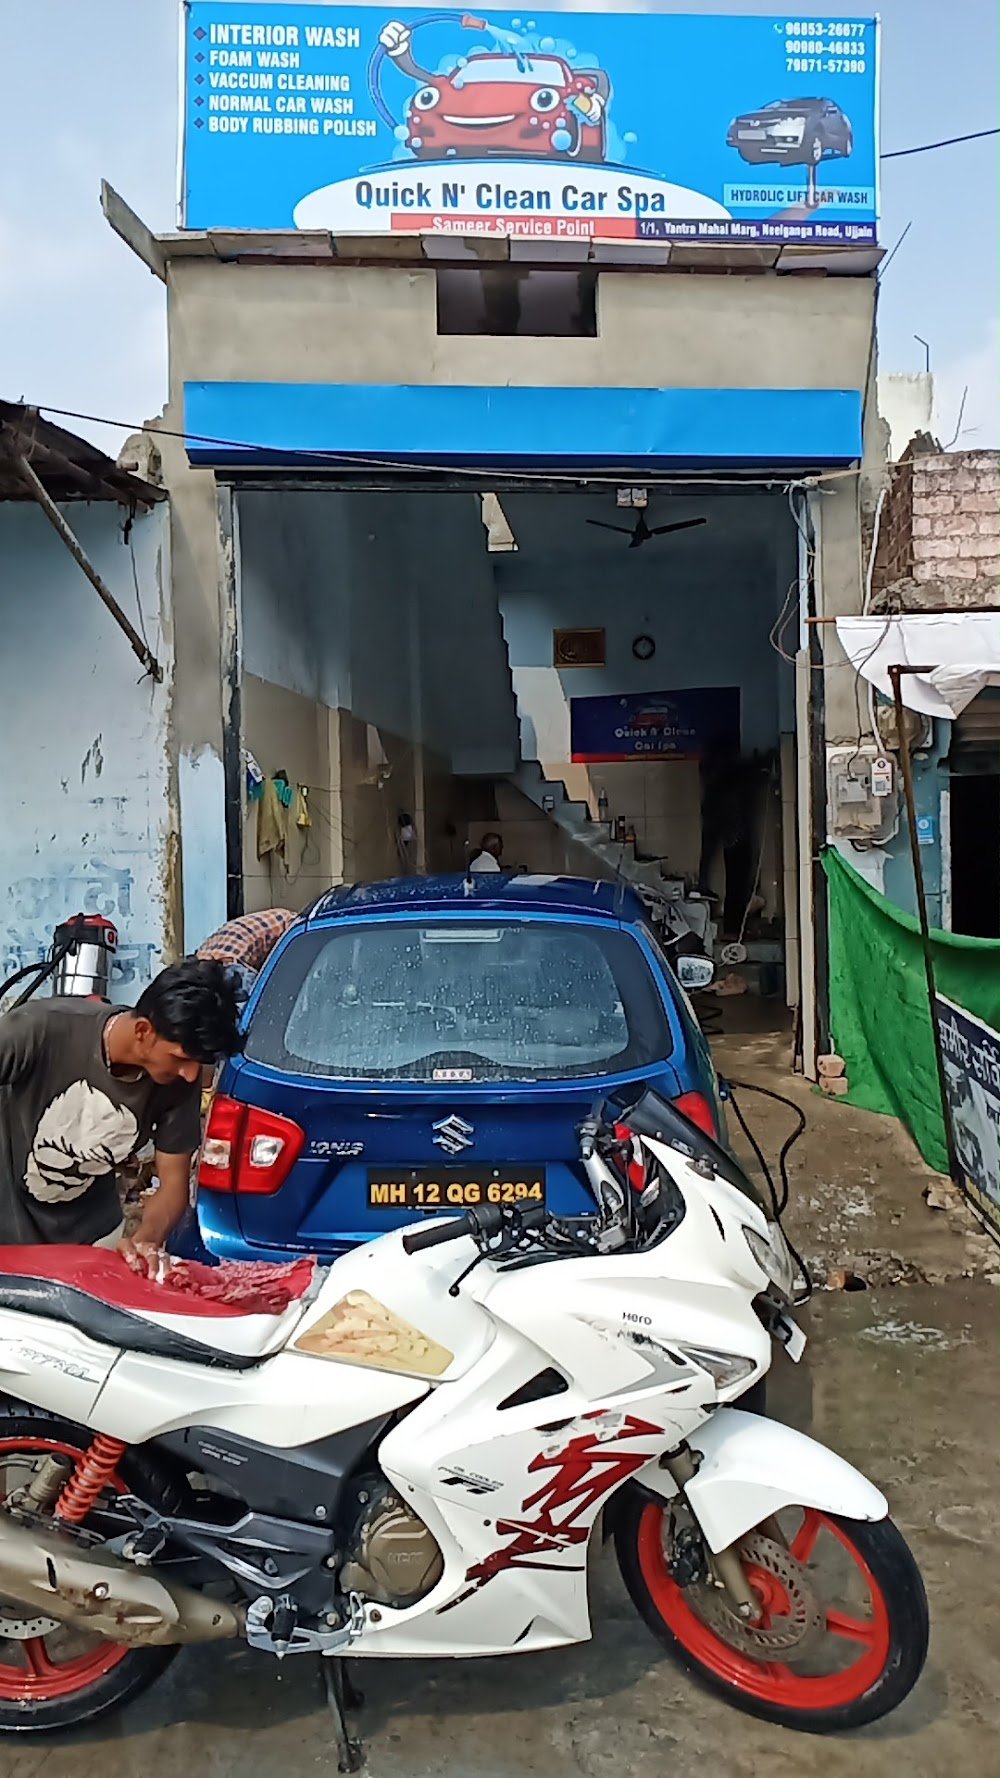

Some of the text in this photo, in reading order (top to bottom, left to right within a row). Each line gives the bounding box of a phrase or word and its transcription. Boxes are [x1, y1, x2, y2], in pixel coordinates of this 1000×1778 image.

[210, 24, 360, 48] INTERIOR WASH
[209, 50, 300, 68] FOAM WASH
[209, 72, 350, 92] VACCUM CLEANING
[209, 95, 354, 114] NORMAL CAR WASH
[208, 116, 377, 137] BODY RUBBING POLISH
[355, 180, 665, 219] Quick N' Clean Car Spa
[731, 189, 868, 204] HYDROLIC LIFT CAR WASH
[432, 216, 595, 236] Sameer Service Point
[664, 223, 696, 235] Yantra
[700, 223, 728, 236] Mahal
[845, 225, 873, 240] Ujjain
[370, 1182, 543, 1204] MH 12 QG 6294
